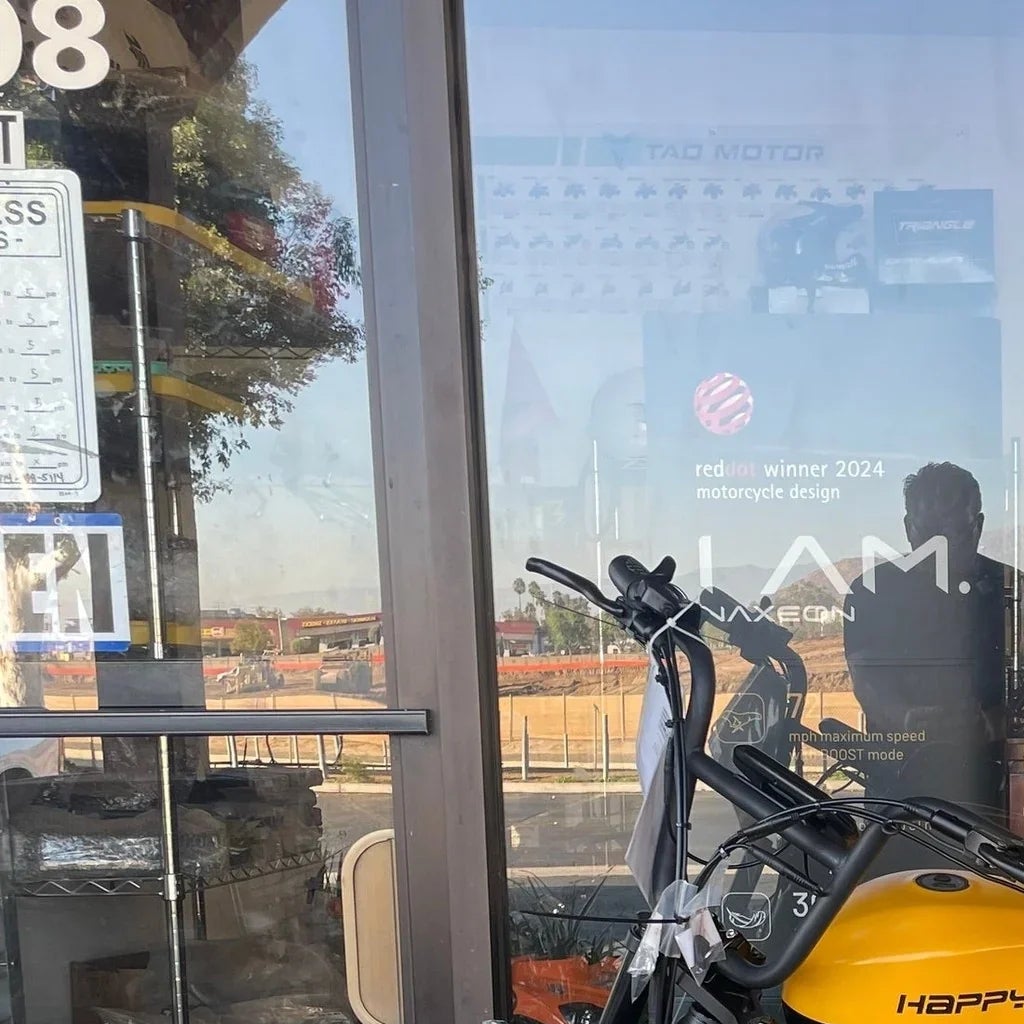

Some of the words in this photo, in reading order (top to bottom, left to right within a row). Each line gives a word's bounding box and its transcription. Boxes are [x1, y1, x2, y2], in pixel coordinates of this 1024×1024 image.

[715, 144, 825, 161] MOTOR
[763, 459, 828, 478] winner
[835, 460, 886, 478] 2024
[696, 484, 784, 503] motorcycle
[789, 484, 840, 503] design
[699, 535, 714, 595] I
[821, 731, 884, 743] maximum
[886, 730, 926, 744] speed
[867, 749, 904, 761] mode
